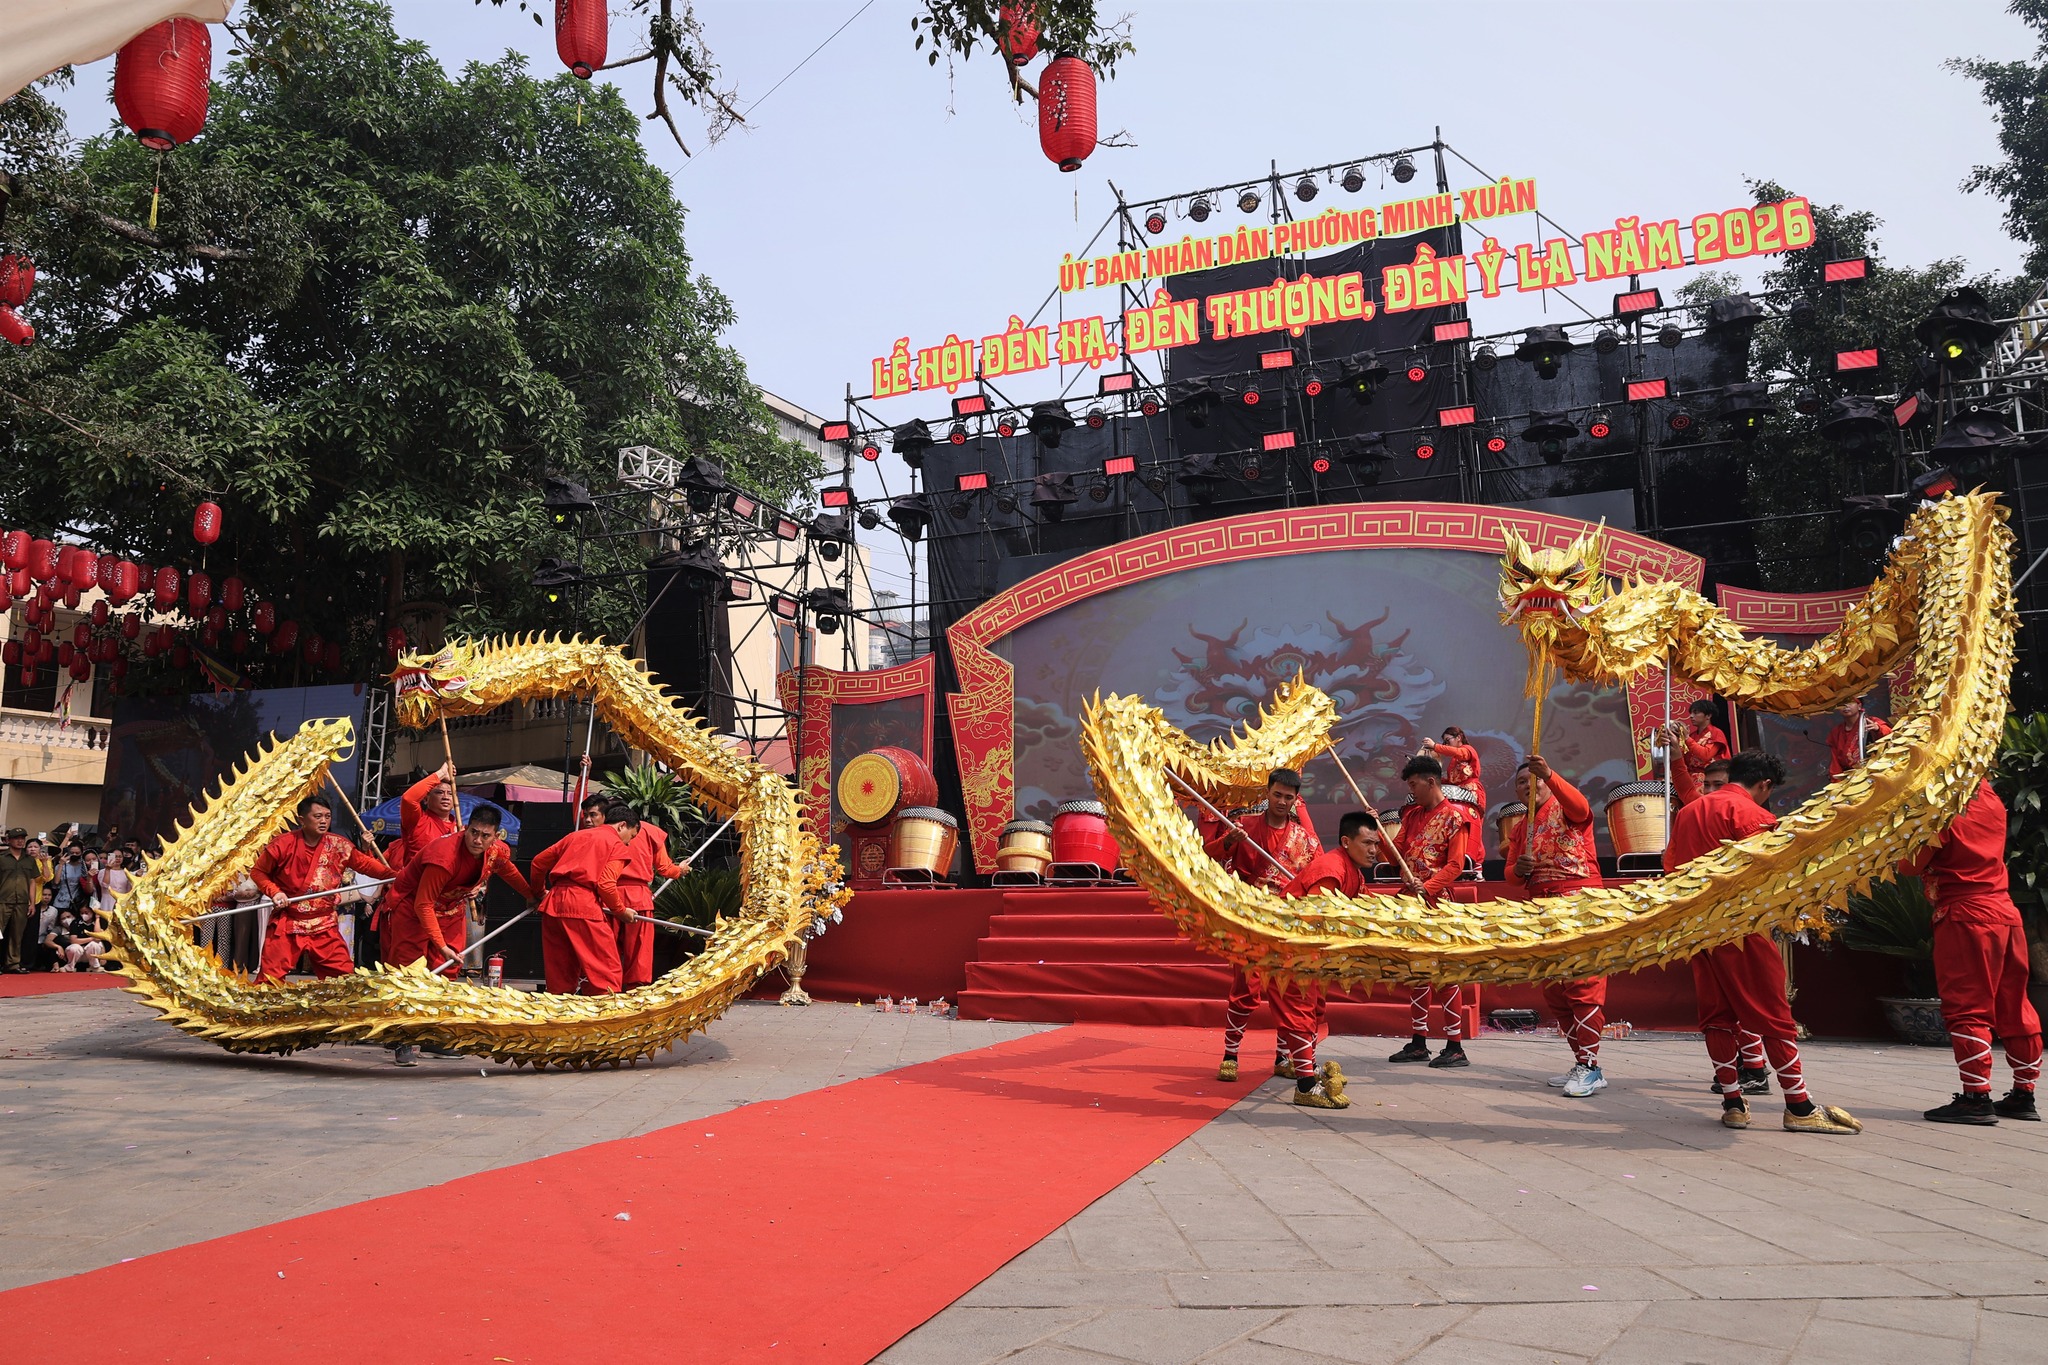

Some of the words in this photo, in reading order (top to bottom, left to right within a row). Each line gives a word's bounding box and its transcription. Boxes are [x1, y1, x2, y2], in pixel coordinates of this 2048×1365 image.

[873, 339, 910, 398] LỄ
[916, 335, 974, 393] HỘI
[982, 318, 1048, 376] ĐỀN
[1057, 318, 1117, 368] HẠ,
[1126, 290, 1198, 353] ĐỀN
[1209, 274, 1374, 337] THƯỢNG,
[1384, 245, 1466, 311] ĐỀN
[1475, 238, 1504, 296] Ỷ
[1516, 240, 1576, 290] LA
[1585, 217, 1682, 279] NĂM
[1694, 199, 1812, 262] 2026
[1059, 252, 1089, 292] ỦY
[1094, 251, 1141, 287] BAN
[1146, 235, 1213, 278] NHÂN
[1218, 225, 1269, 265] DÂN
[1274, 208, 1377, 255] PHƯỜNG
[1382, 193, 1454, 236] MINH
[1459, 176, 1536, 222] XUÂN
